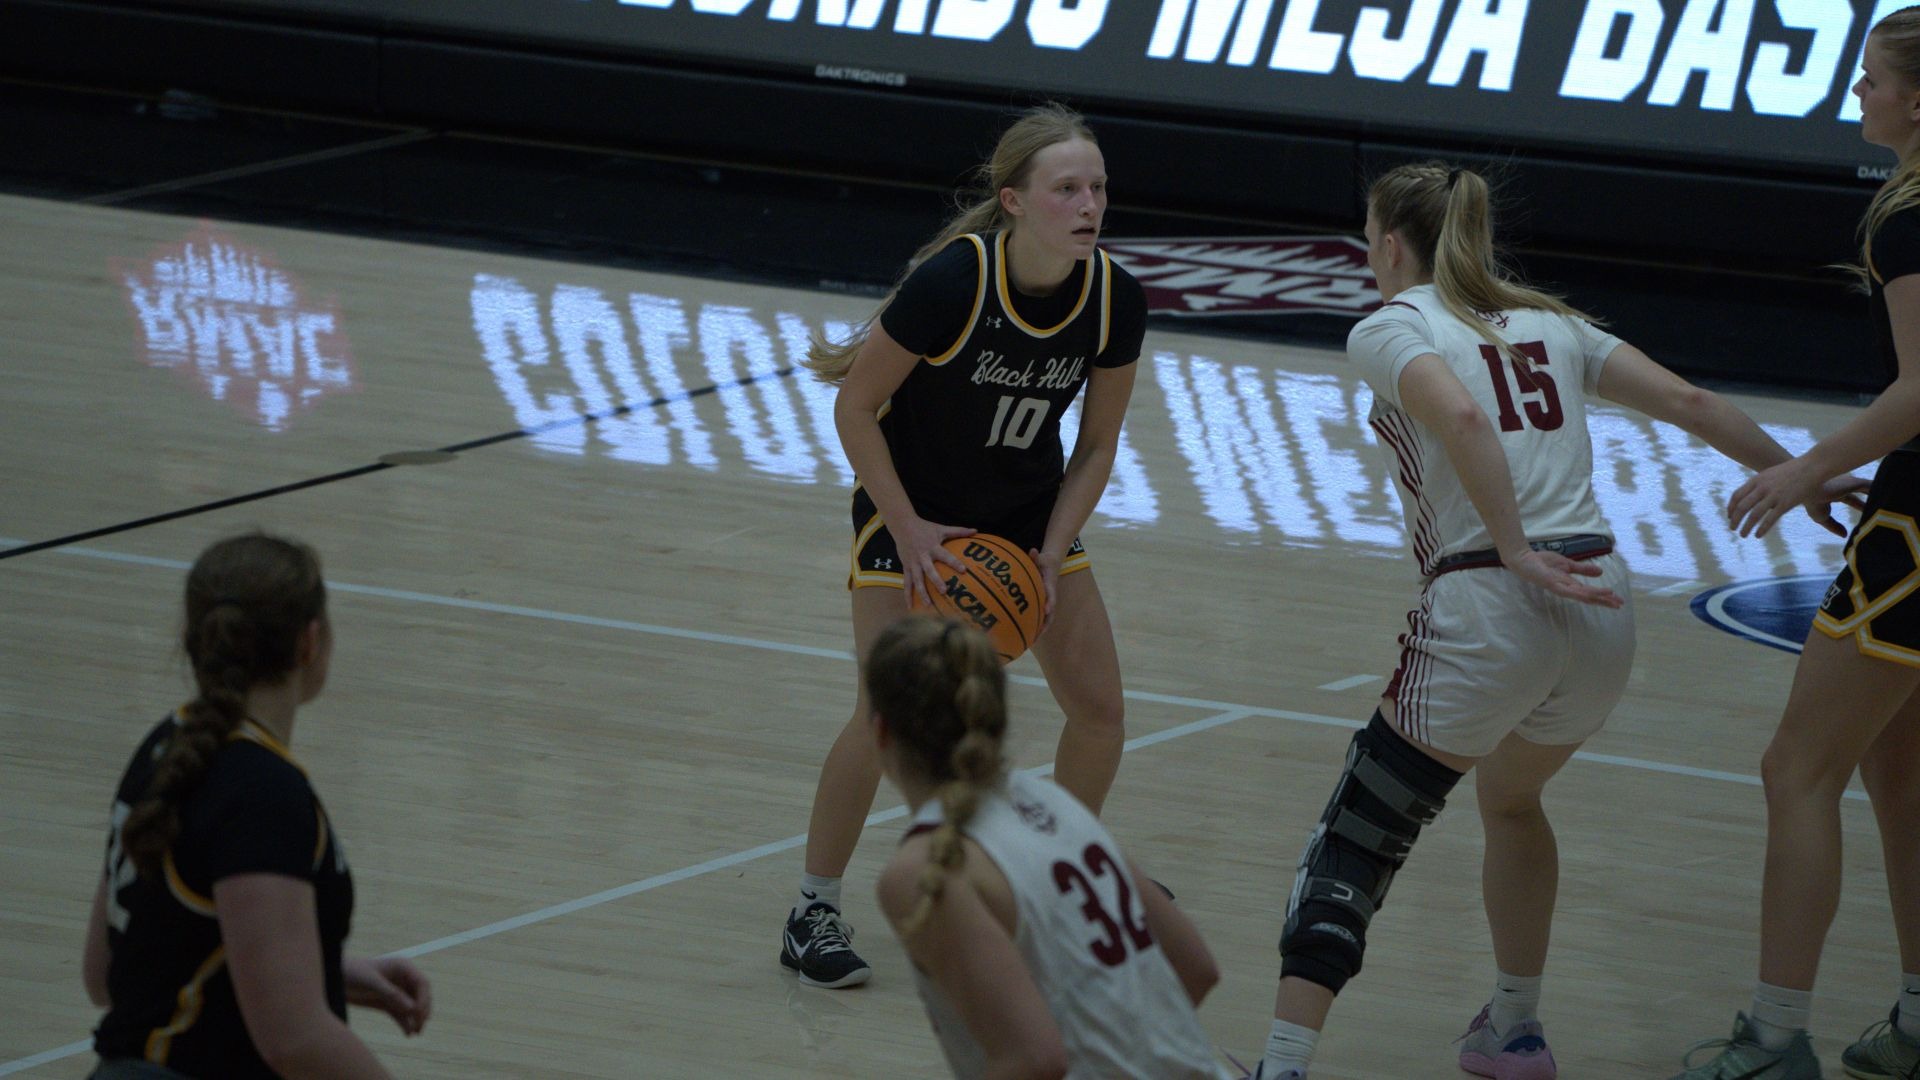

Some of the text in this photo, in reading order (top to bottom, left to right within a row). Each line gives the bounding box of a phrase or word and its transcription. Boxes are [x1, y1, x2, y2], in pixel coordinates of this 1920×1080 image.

[971, 349, 1034, 388] Black
[1478, 340, 1564, 432] 15
[984, 395, 1051, 450] 10
[946, 575, 998, 629] NCAA
[963, 541, 1029, 615] Wilson
[1053, 844, 1152, 966] 32
